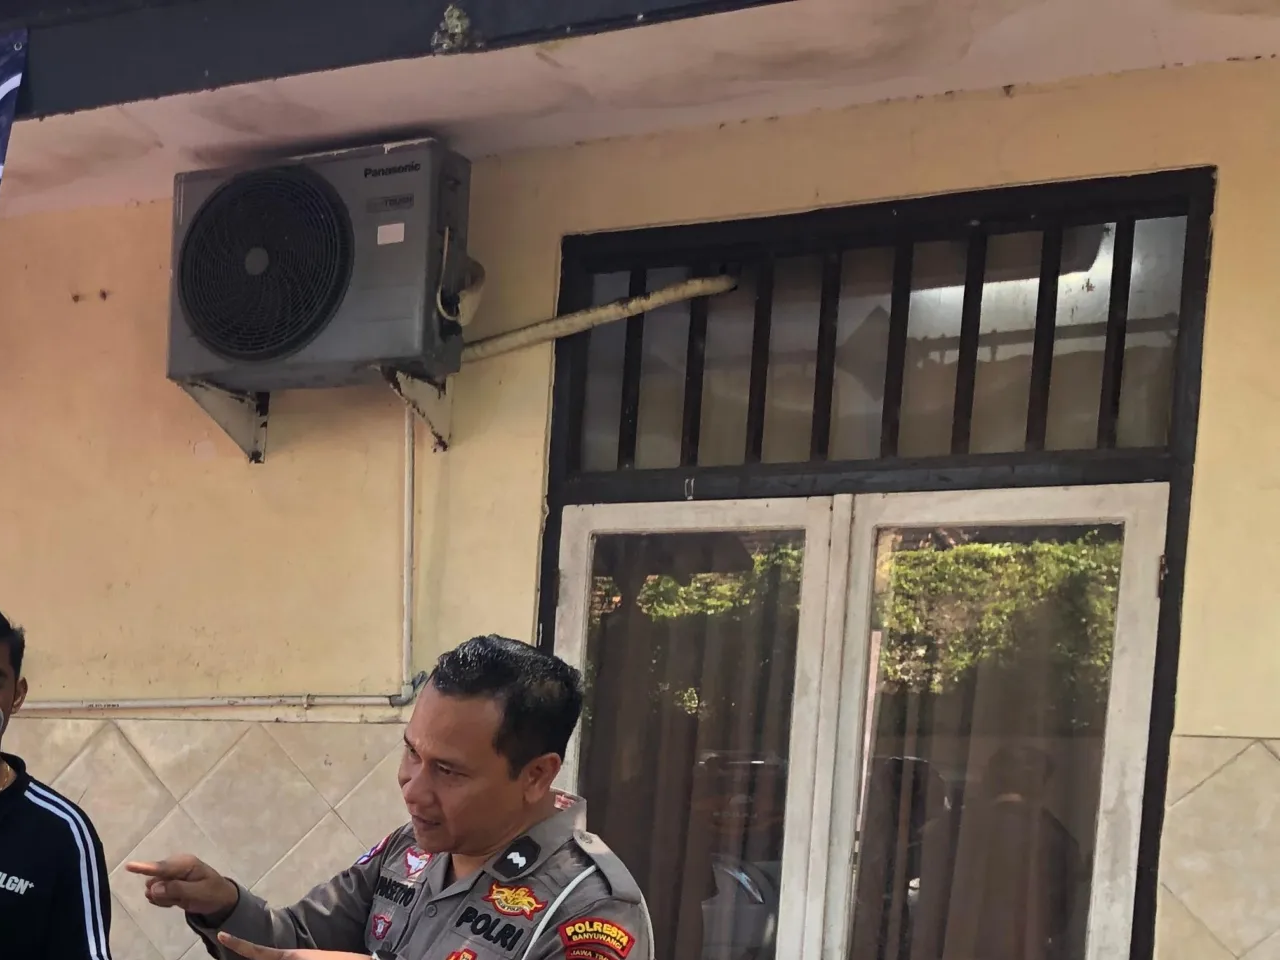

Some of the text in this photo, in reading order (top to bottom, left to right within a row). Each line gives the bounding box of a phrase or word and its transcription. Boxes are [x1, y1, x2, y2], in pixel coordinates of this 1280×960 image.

[363, 161, 421, 178] Panasonic
[455, 905, 524, 951] POLRI
[565, 920, 629, 947] POLRESTA
[572, 932, 623, 950] BANYUWANGI
[570, 949, 593, 957] JAWA
